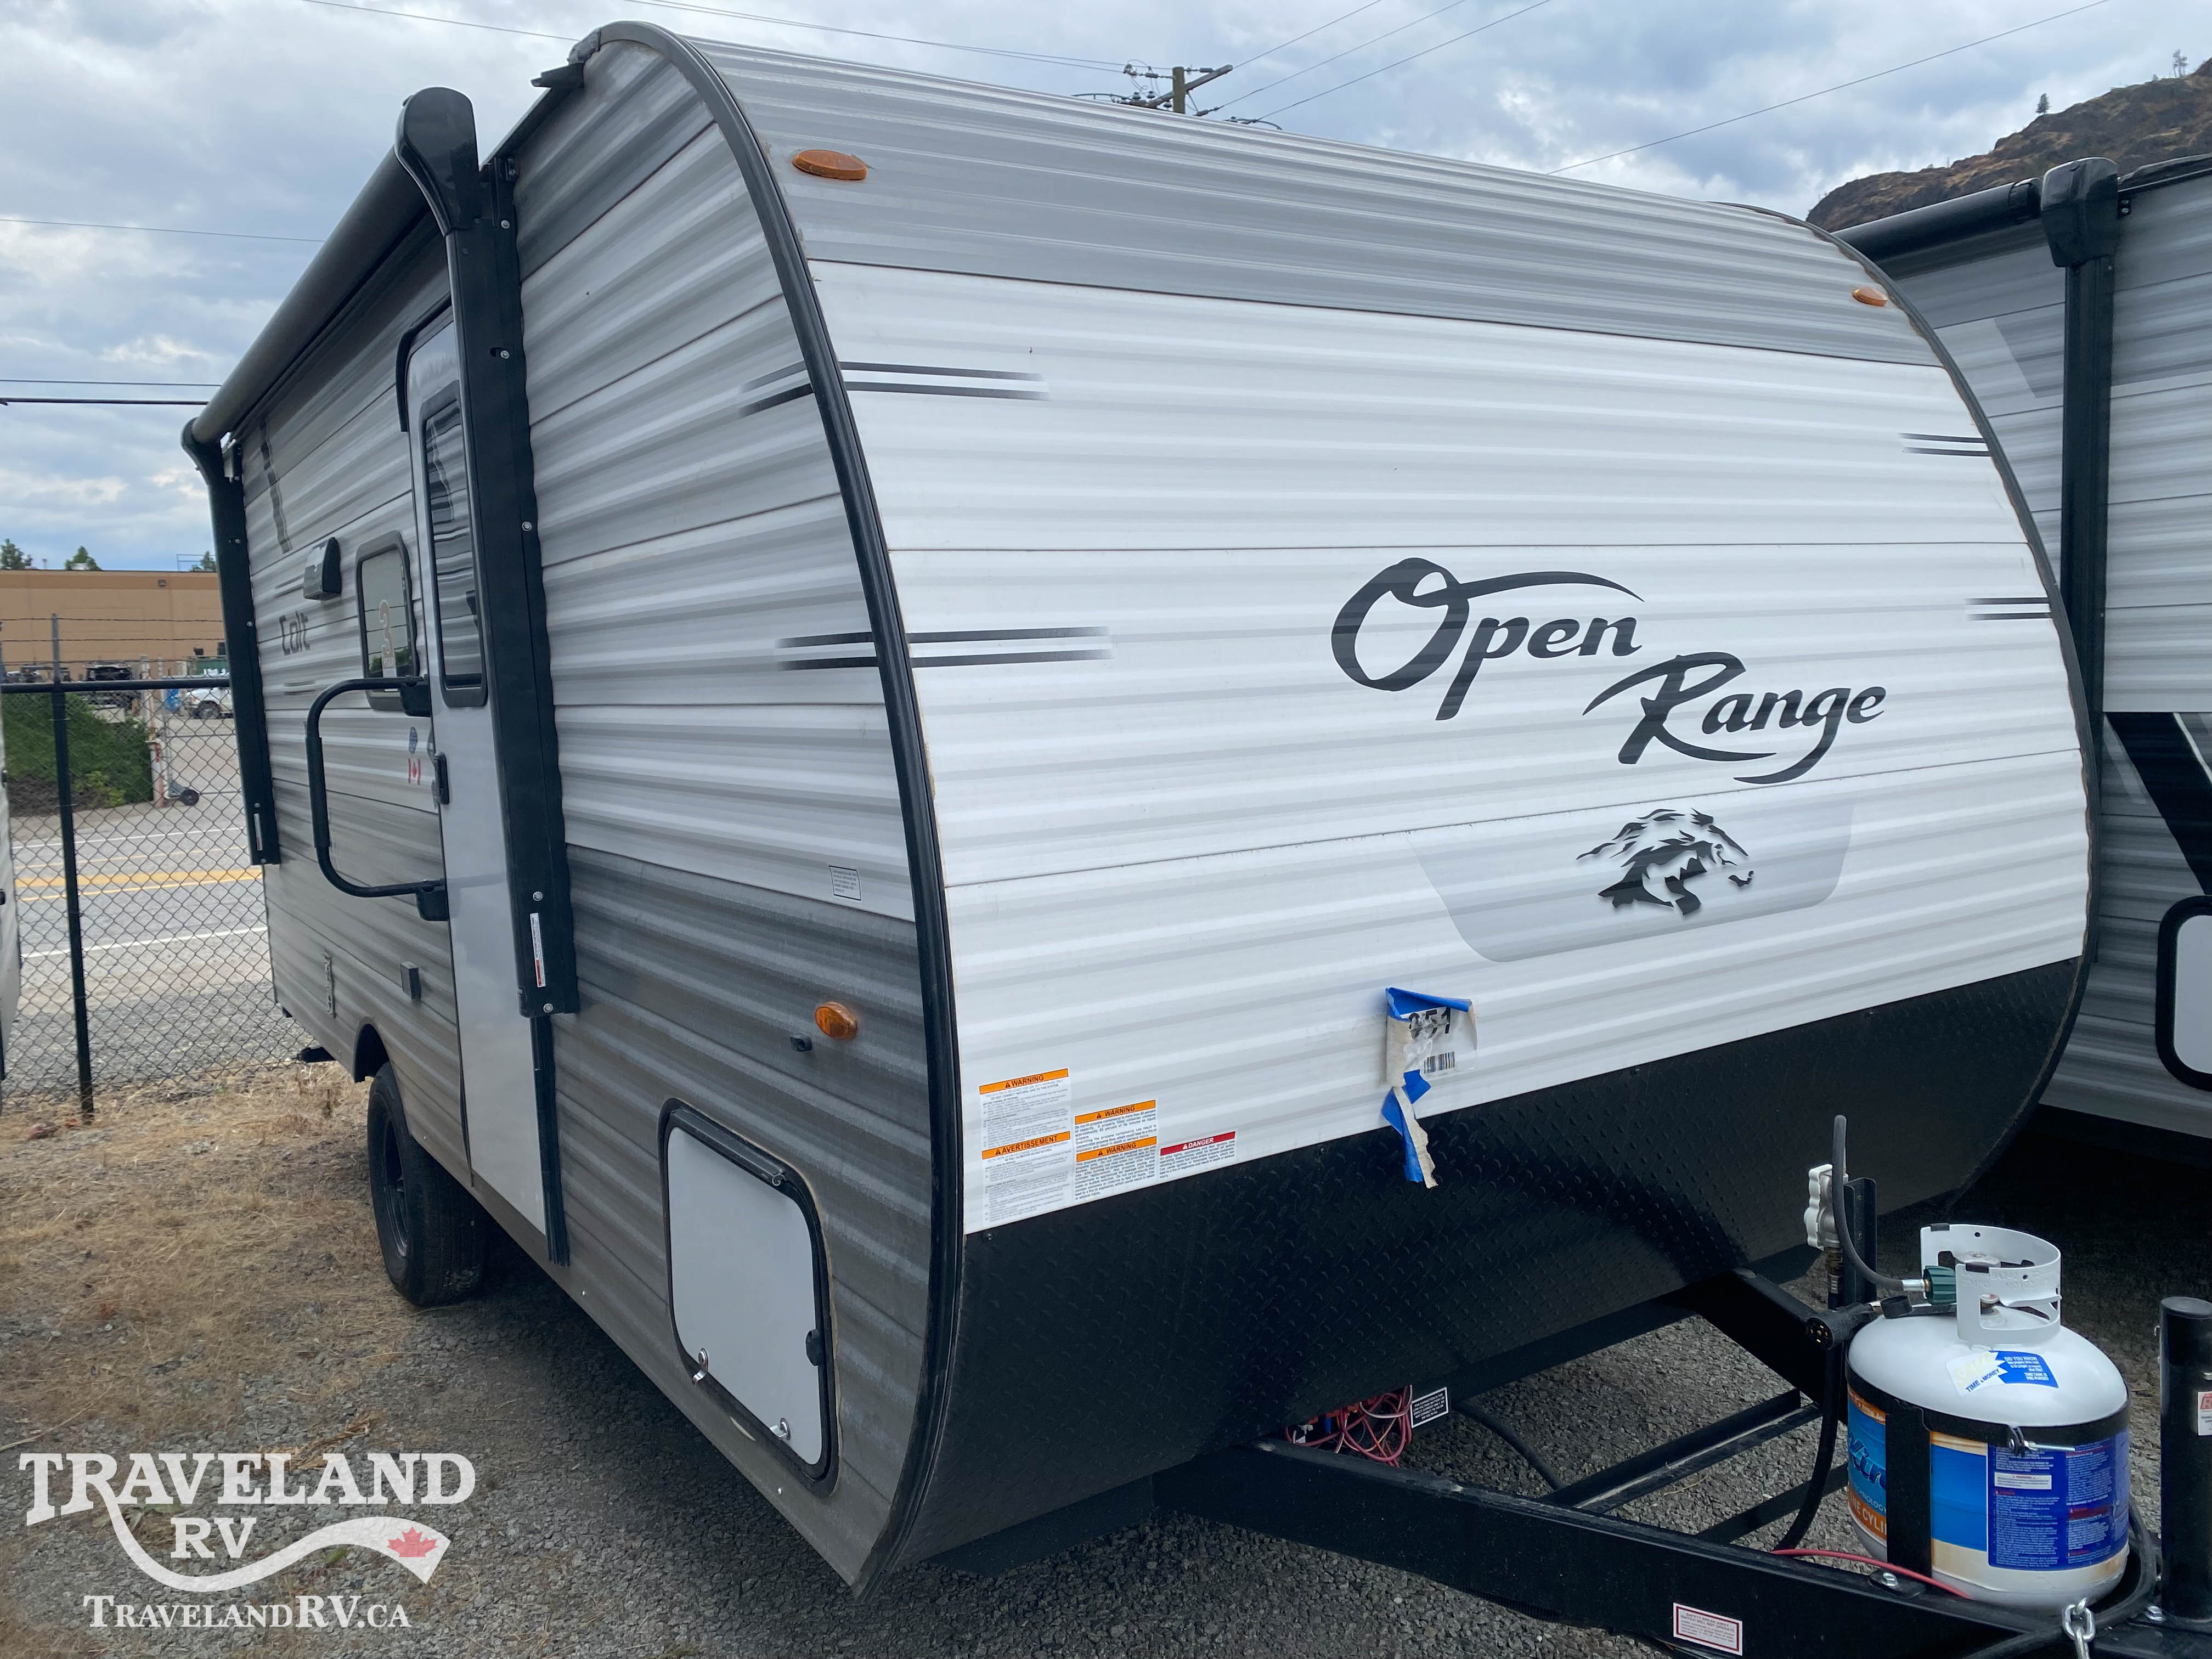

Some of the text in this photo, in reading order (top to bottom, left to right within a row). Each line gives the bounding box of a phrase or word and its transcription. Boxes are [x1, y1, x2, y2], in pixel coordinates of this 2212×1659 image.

[1331, 558, 1886, 783] Open Range
[1011, 1075, 1043, 1086] WARNING
[1105, 1105, 1135, 1116] WARNING
[1002, 1135, 1057, 1154] AVERTISSEMENT
[1107, 1142, 1136, 1154] WARNING
[1188, 1137, 1214, 1148] DANGER
[1966, 1380, 1980, 1392] TIME
[1983, 1368, 2000, 1381] MONEY
